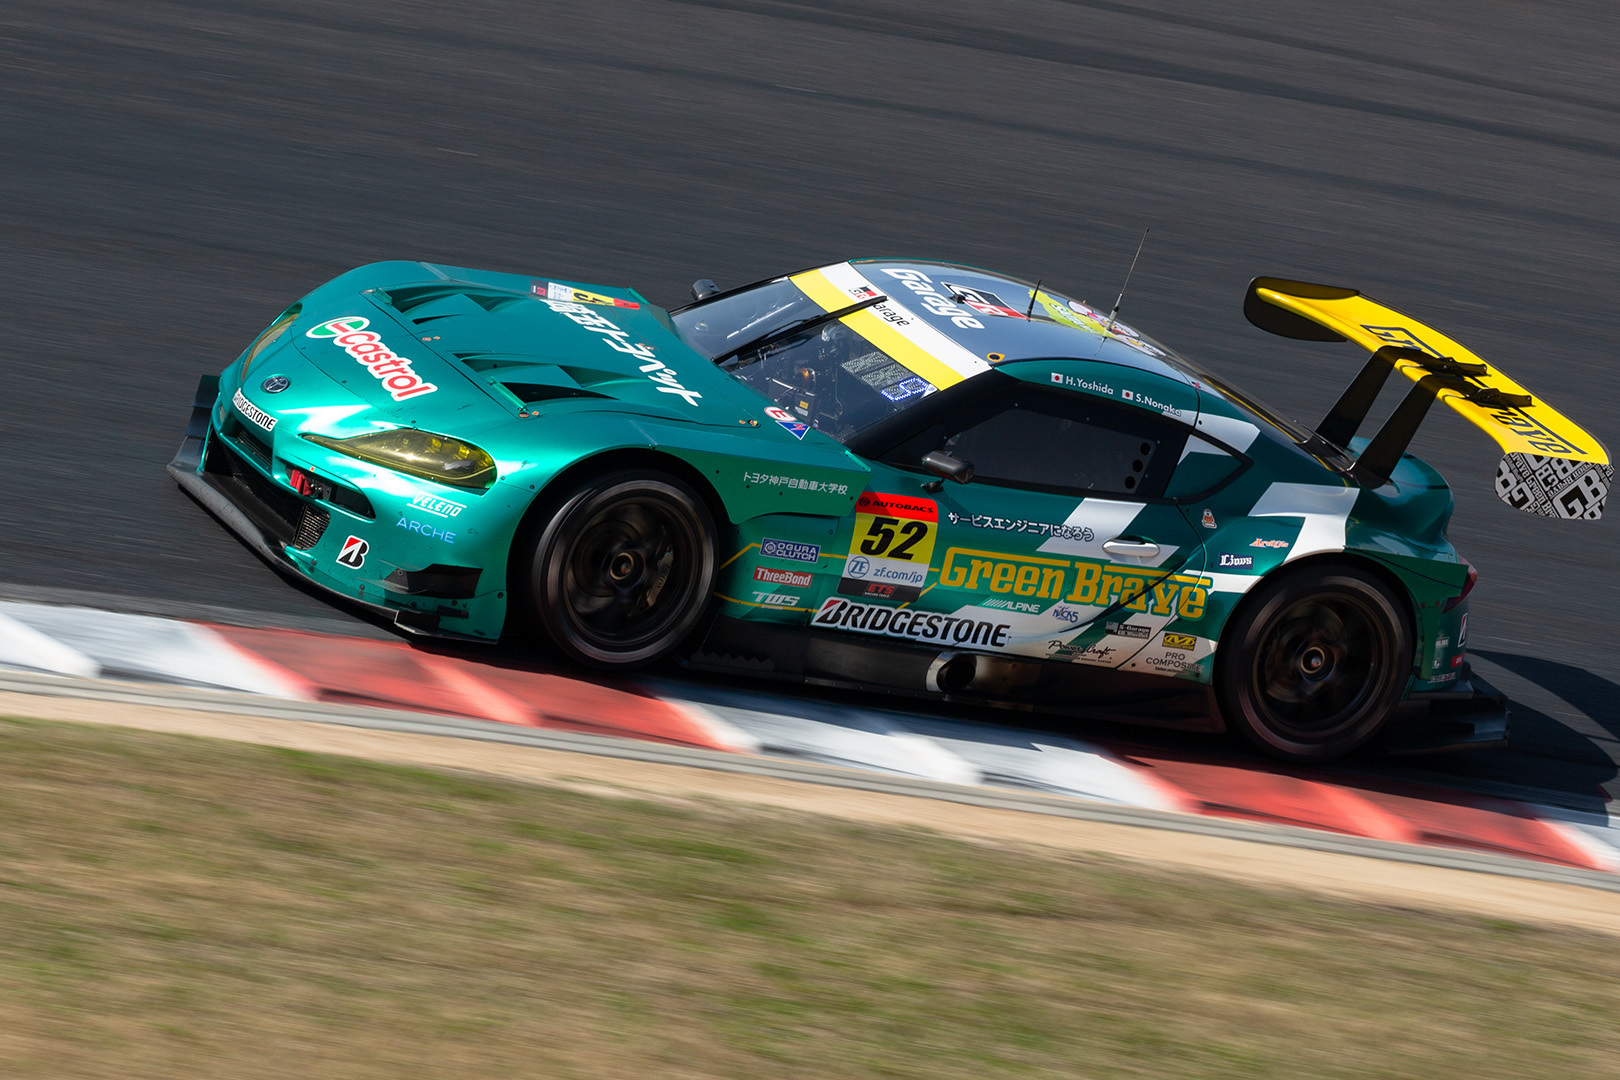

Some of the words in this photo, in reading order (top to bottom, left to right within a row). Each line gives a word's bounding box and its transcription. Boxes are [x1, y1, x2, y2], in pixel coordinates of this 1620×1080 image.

[880, 268, 985, 329] Garage
[870, 300, 910, 327] arage
[337, 332, 433, 398] Castrol
[1065, 376, 1114, 396] H.Yoshida
[1136, 393, 1182, 417] S.Nonaka
[743, 472, 848, 495] トヨタ神戸自動車大学校
[872, 500, 934, 514] AUTOBACS
[396, 517, 457, 544] ARCHE
[947, 512, 1095, 541] サービスエンジニアになろう
[860, 516, 929, 560] 52
[776, 548, 816, 561] CLUTCH
[777, 543, 817, 554] OGURA
[849, 557, 869, 576] ZF
[1220, 554, 1252, 566] Lions
[756, 567, 811, 586] ThreeBond
[873, 567, 923, 584] zf.com/jp
[939, 547, 1071, 600] Green
[1066, 561, 1211, 618] Brave
[867, 583, 896, 595] ETS
[752, 591, 801, 607] TWS
[1004, 600, 1041, 613] ALPINE
[815, 600, 1011, 647] BRIDGESTONE
[1086, 643, 1117, 660] Craft
[1165, 651, 1186, 661] PRO
[1145, 657, 1205, 673] COMPOSITE
